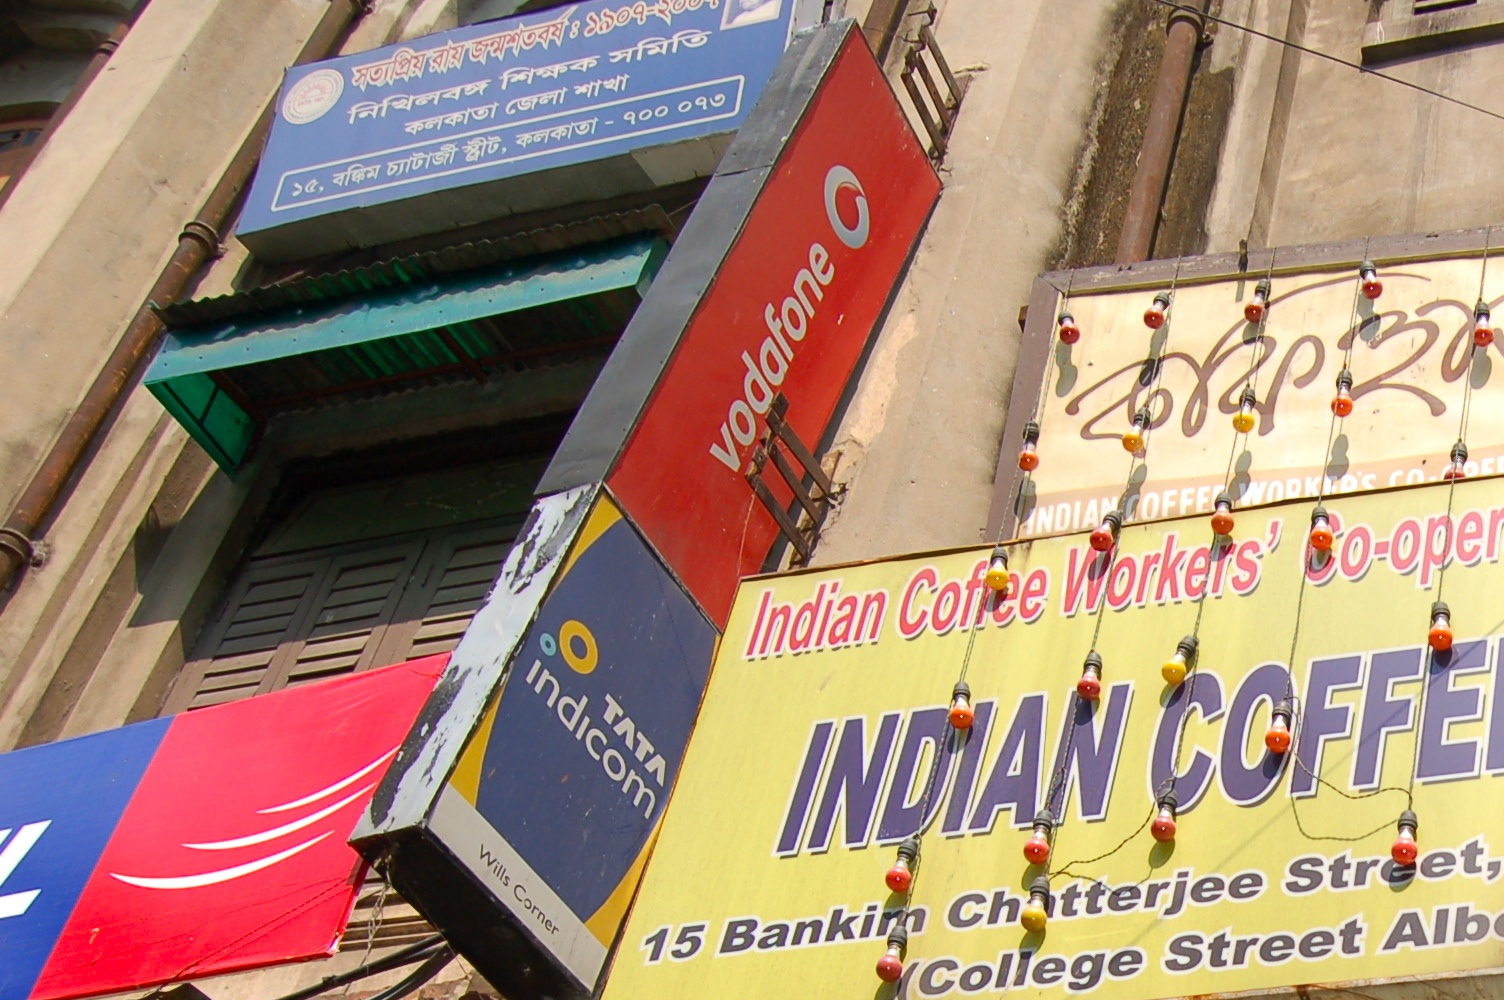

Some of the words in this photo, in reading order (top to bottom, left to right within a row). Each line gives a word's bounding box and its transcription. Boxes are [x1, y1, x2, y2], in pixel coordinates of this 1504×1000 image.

[404, 101, 499, 135] কলকাতা
[504, 86, 568, 115] জেলা
[574, 73, 630, 98] শাখা
[499, 55, 602, 91] শিক্ষক
[608, 29, 713, 63] সমিতি
[292, 177, 325, 197] ১৫,
[515, 117, 598, 149] কলকাতা
[623, 104, 669, 125] ৭০০
[677, 92, 726, 112] ০৭৩
[709, 242, 835, 473] vodafone
[746, 579, 886, 657] Indian
[1064, 520, 1279, 612] Workers'
[526, 657, 656, 820] indicom
[602, 693, 667, 787] TATA
[777, 684, 1131, 853] INDIAN
[479, 844, 511, 888] Wills
[513, 883, 560, 936] Corner
[645, 926, 703, 964] 15
[720, 905, 926, 954] Bankim
[1285, 840, 1499, 893] Street,
[1166, 918, 1364, 981] Street
